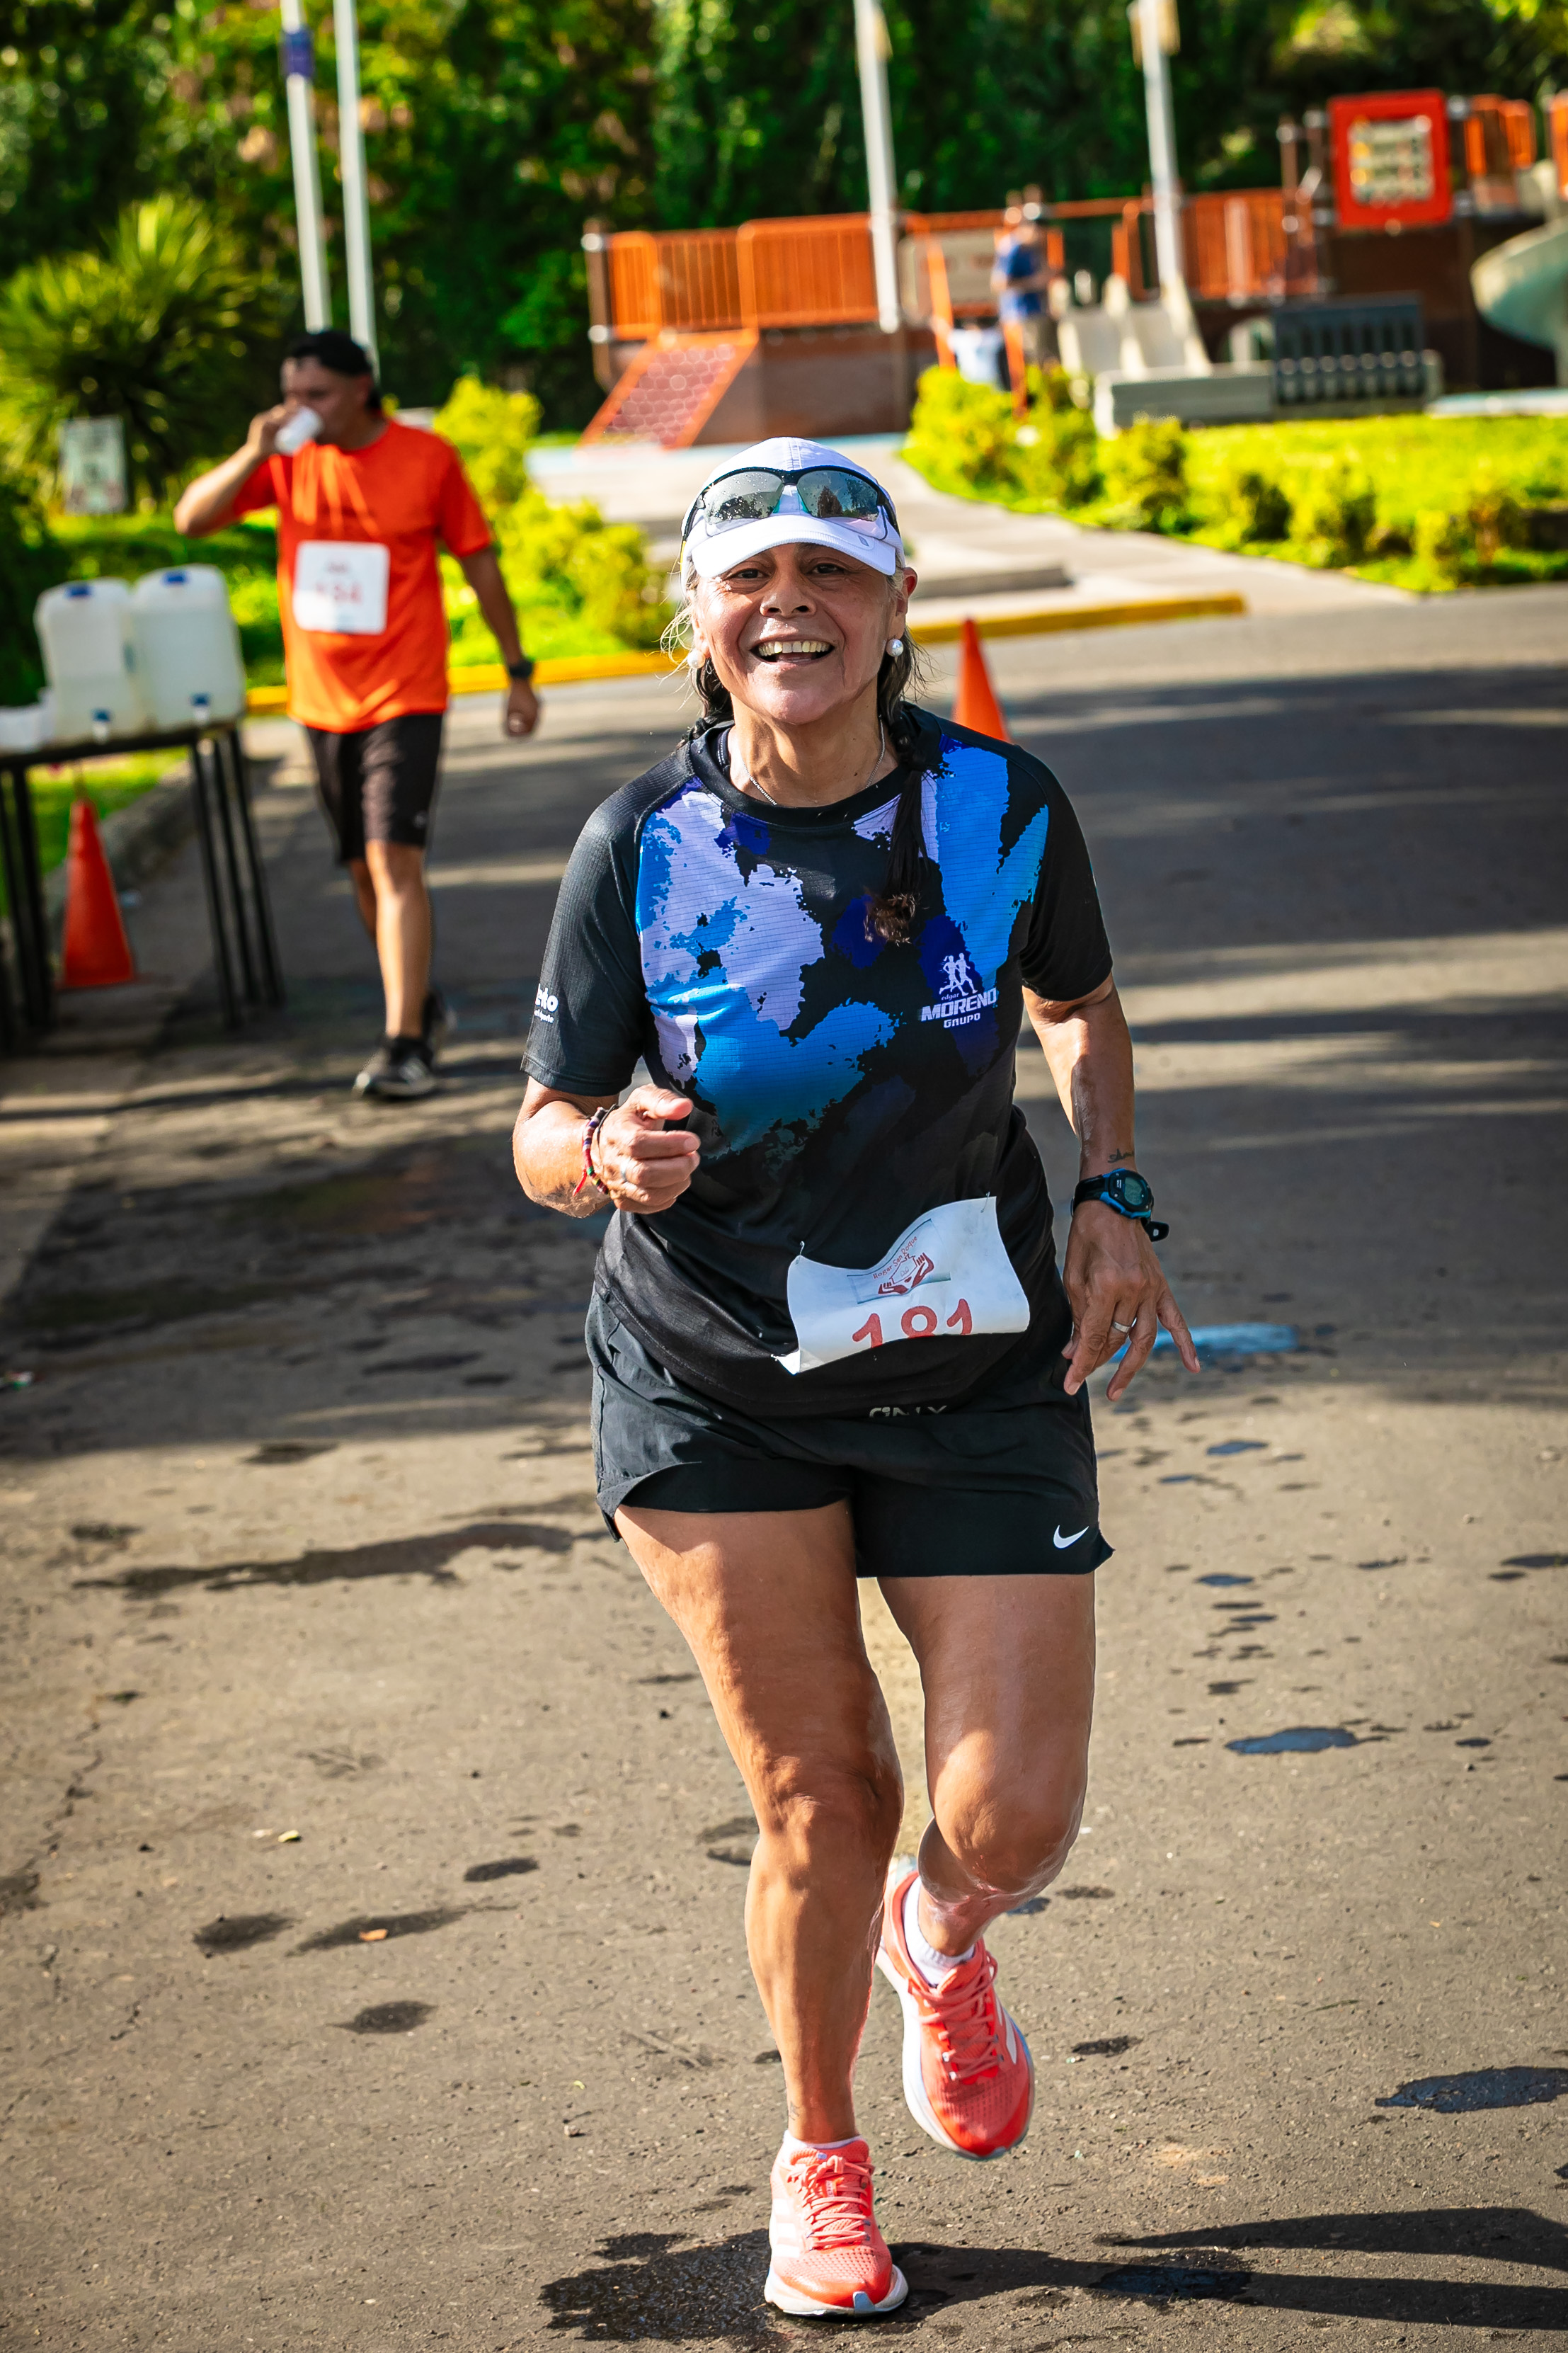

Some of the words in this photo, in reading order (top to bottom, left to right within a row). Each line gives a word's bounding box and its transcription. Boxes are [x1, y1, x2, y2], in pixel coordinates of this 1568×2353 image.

[920, 987, 997, 1022] MORENO
[941, 993, 960, 1001] edgar
[943, 1013, 981, 1028] GRUPO
[872, 1265, 893, 1280] Hogar
[893, 1254, 903, 1267] San
[900, 1236, 918, 1256] Roque
